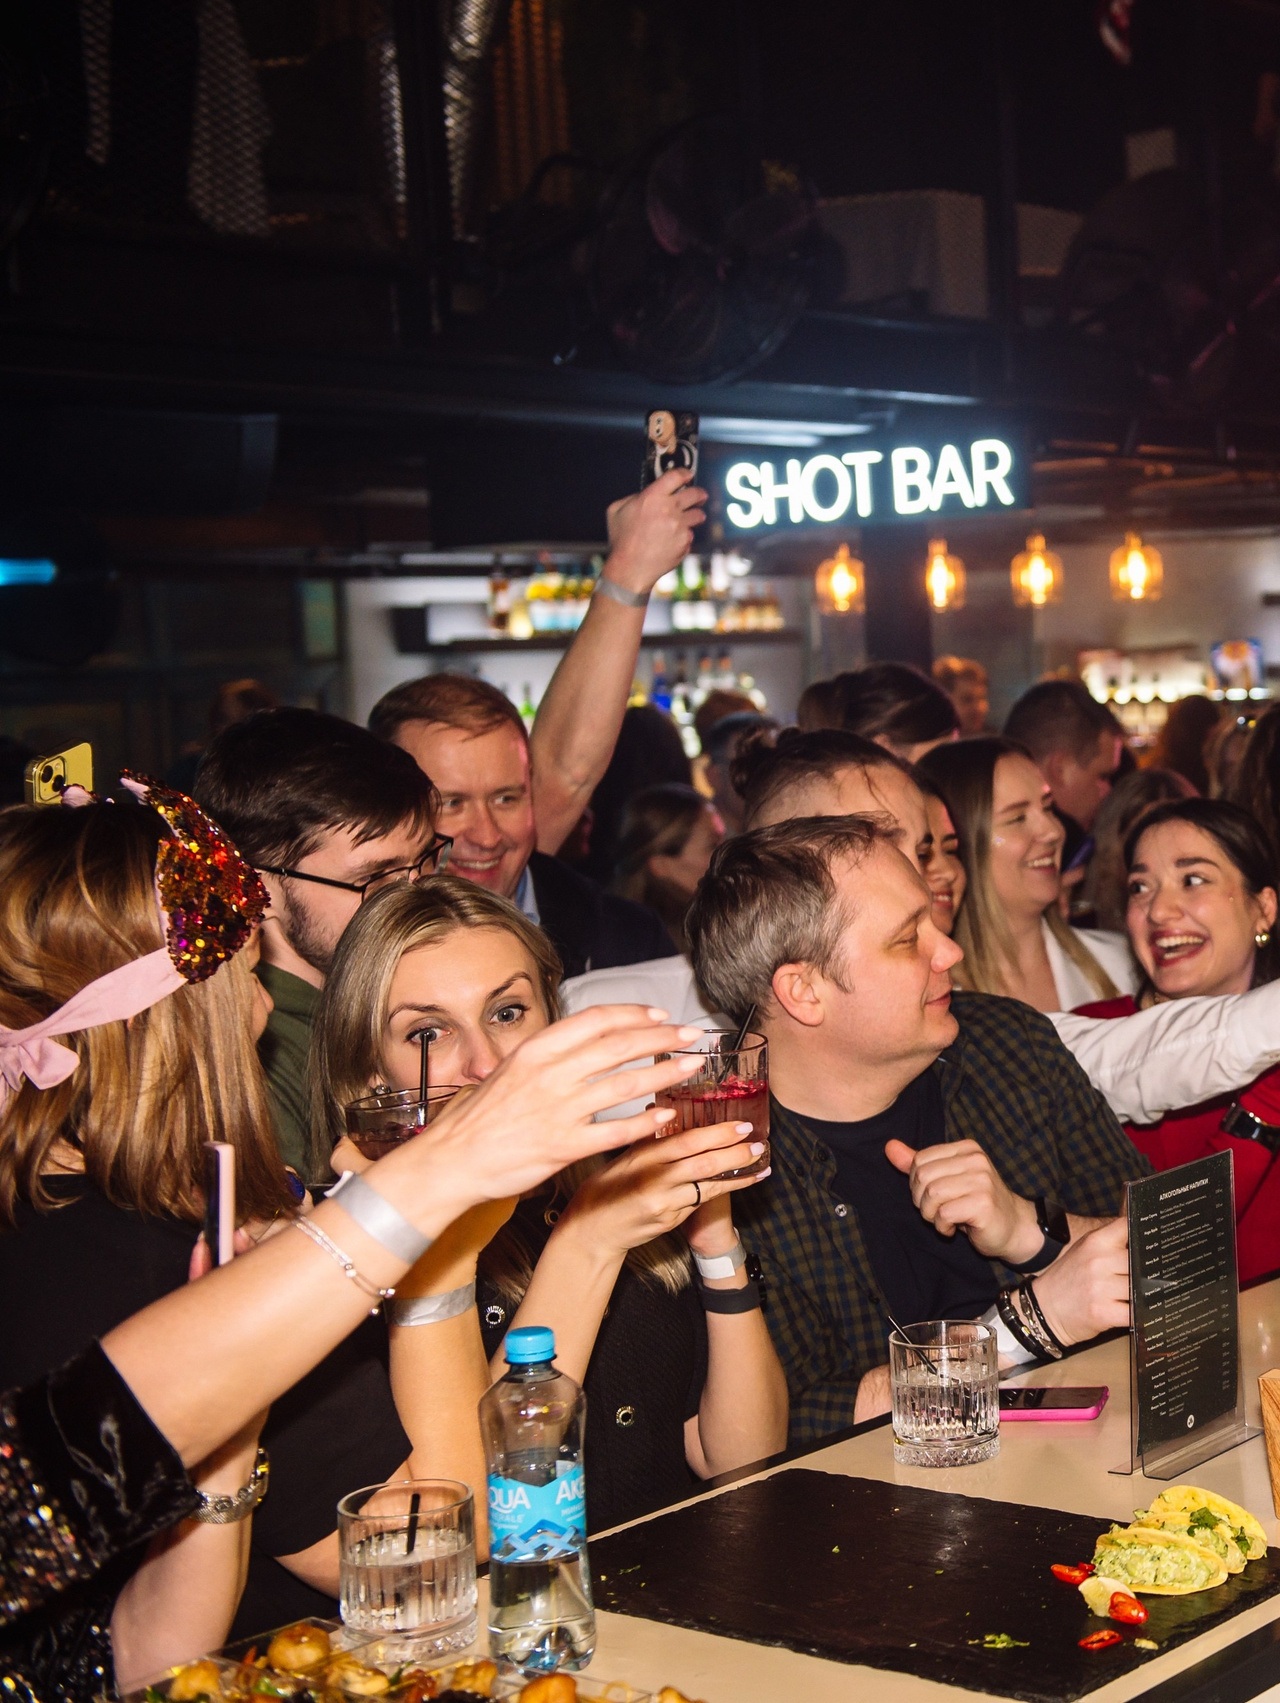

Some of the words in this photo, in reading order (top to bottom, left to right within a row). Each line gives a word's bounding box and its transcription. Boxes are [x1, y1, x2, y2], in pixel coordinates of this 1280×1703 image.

[726, 451, 883, 528] SHOT
[891, 438, 1015, 515] BAR
[1159, 1184, 1190, 1201] АЛКОГОЛЬНЫЕ
[1189, 1178, 1209, 1191] НАПИТКИ
[489, 1486, 532, 1514] QUA
